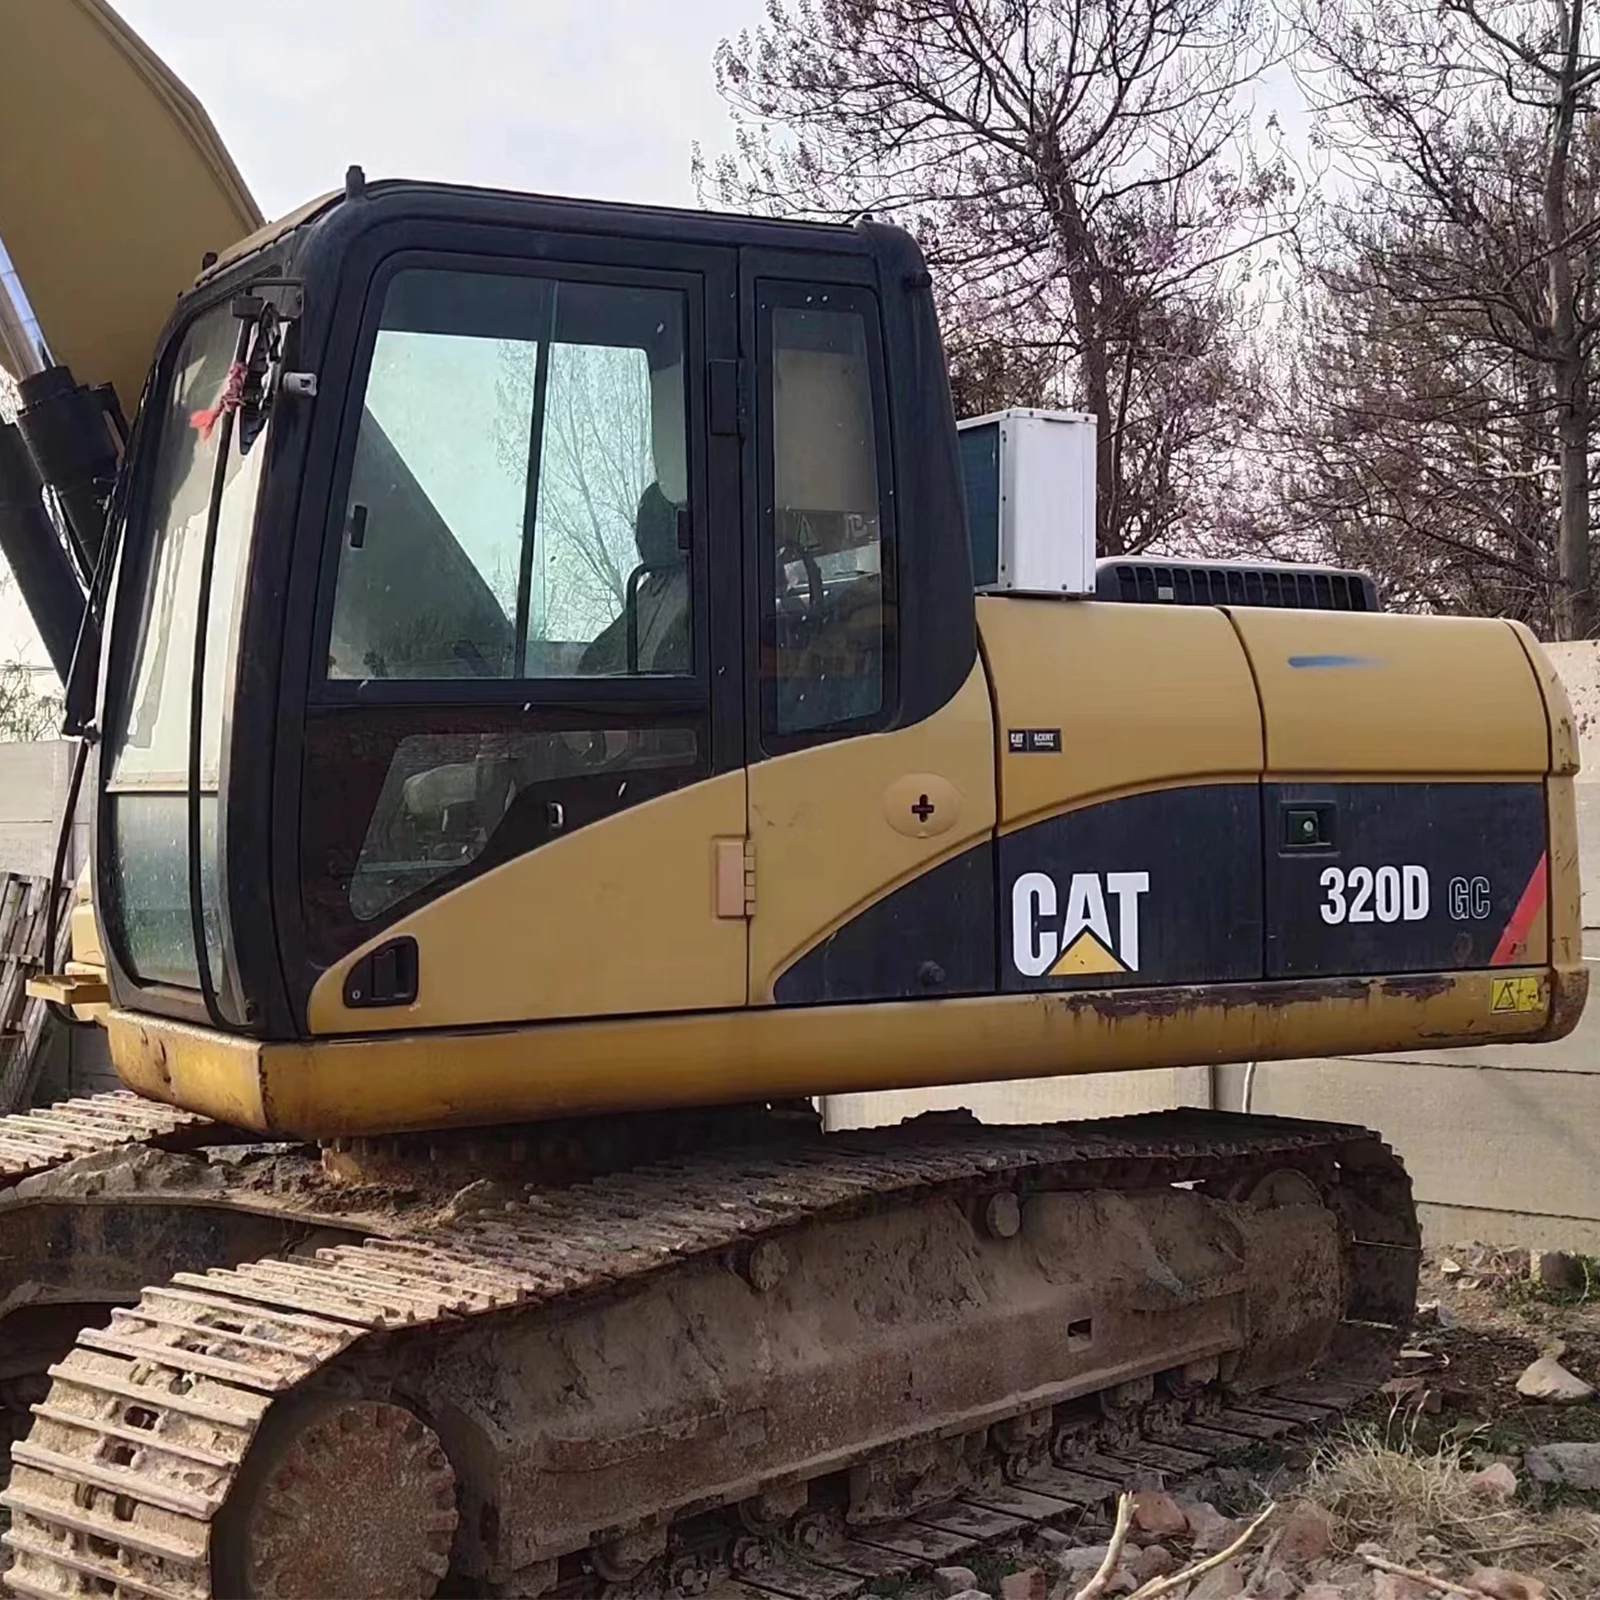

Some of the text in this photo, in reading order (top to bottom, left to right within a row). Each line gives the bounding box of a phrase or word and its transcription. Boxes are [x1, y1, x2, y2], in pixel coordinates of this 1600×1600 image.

[1012, 871, 1150, 977] CAT
[1319, 865, 1491, 925] 320D GC
